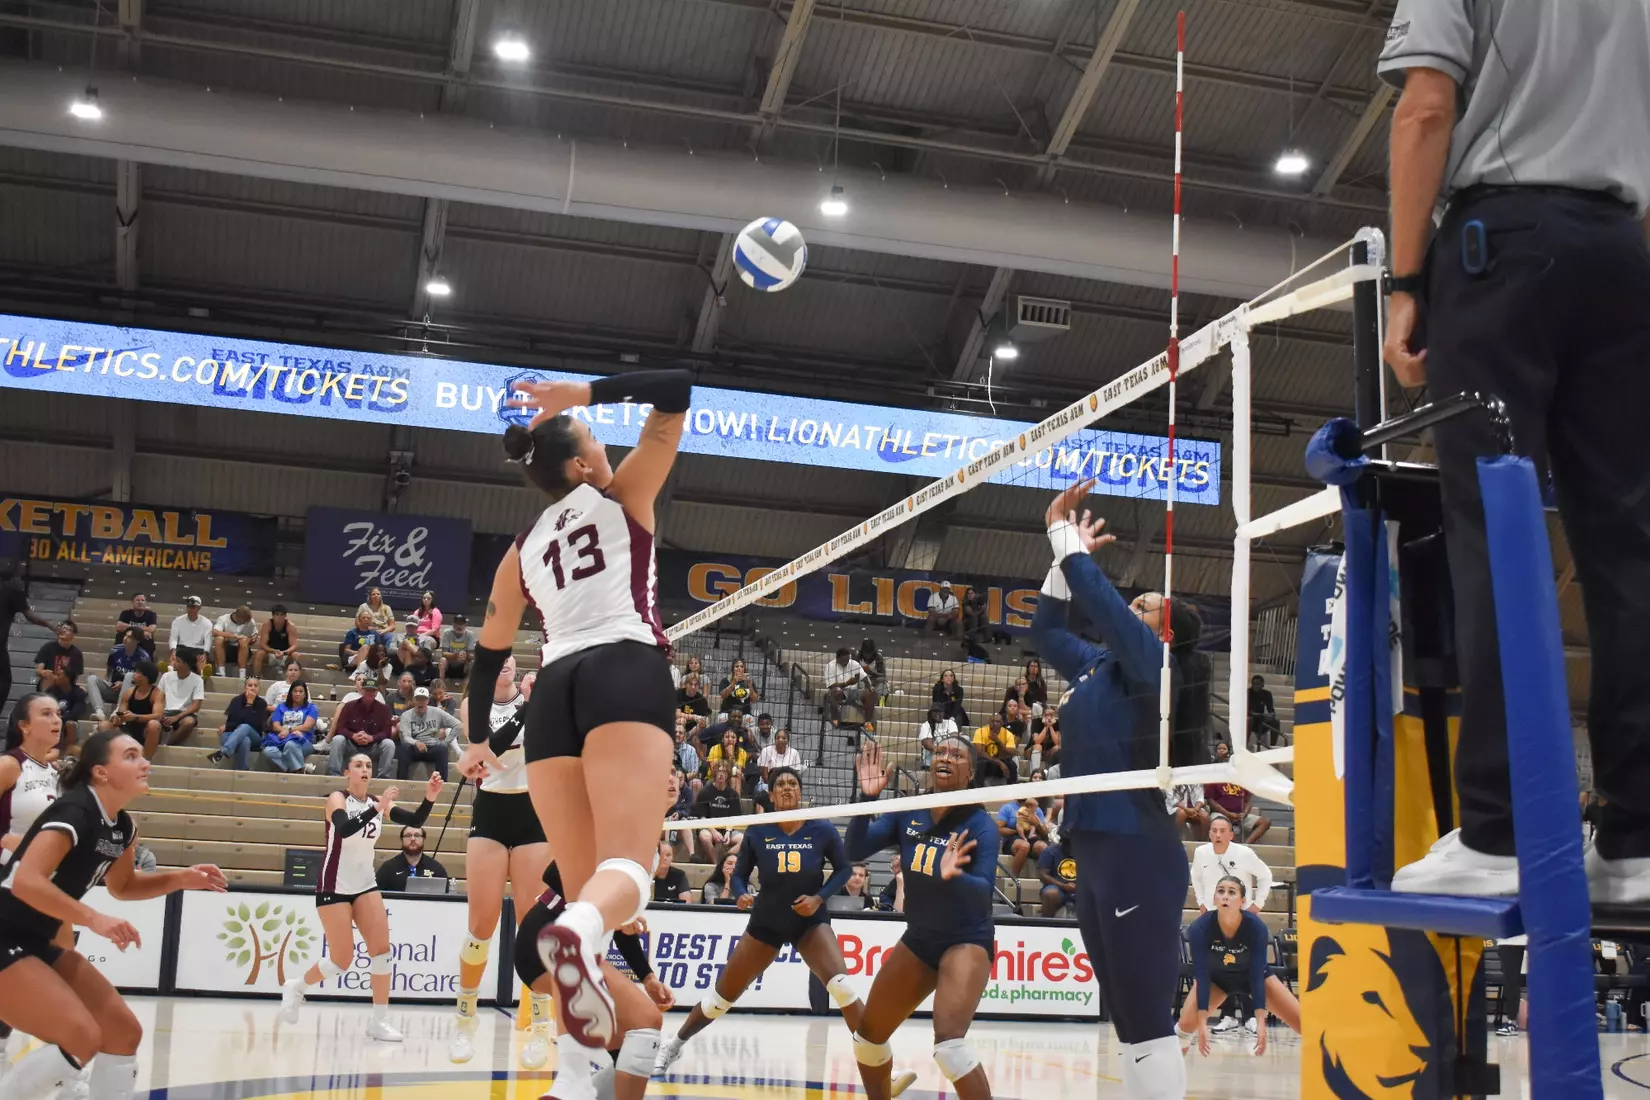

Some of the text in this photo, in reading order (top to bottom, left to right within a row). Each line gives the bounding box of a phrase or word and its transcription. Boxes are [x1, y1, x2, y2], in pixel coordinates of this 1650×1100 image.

[212, 349, 410, 380] EAST TEXAS A&M
[1104, 356, 1169, 402] EAST TEXAS A&M
[436, 381, 506, 414] BUY
[513, 391, 655, 428] TKETS
[768, 416, 1209, 485] LIONATHLETICOM/TICKETS
[1031, 424, 1046, 442] EAST
[1048, 412, 1068, 433] TEXAS
[1102, 441, 1160, 457] TEXAS
[57, 540, 212, 571] ALL-AMERICANS
[343, 522, 428, 567] Fix &
[543, 524, 606, 590] 13
[354, 554, 433, 590] Feed
[688, 562, 797, 608] GO
[362, 821, 376, 838] 12
[777, 851, 801, 873] 19
[911, 843, 937, 876] 11
[322, 933, 436, 969] gnal
[656, 933, 722, 960] BEST
[727, 935, 803, 964] PCE
[837, 934, 1093, 983] Brhire's
[320, 963, 460, 992] eahcare
[657, 962, 765, 991] TO ST!
[981, 983, 1093, 1006] od & pharmacy
